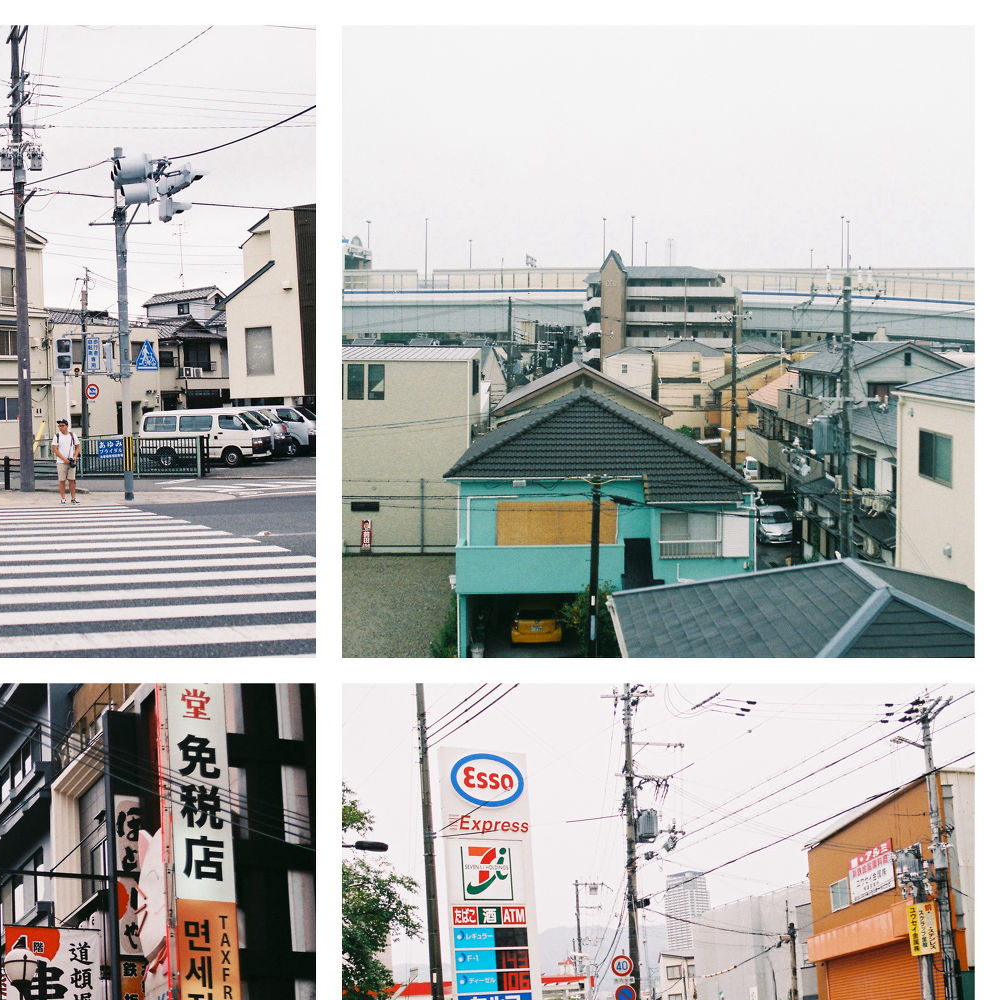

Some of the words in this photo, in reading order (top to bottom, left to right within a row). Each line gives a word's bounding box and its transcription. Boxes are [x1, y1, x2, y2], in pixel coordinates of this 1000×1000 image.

[99, 440, 122, 448] あゆみ
[181, 689, 211, 721] 堂
[463, 766, 514, 791] Esso
[178, 734, 223, 881] 免税店
[459, 815, 529, 834] Express
[454, 908, 476, 923] たばこ
[482, 908, 497, 923] 酒
[503, 908, 525, 923] ATM
[467, 954, 479, 962] F-1
[501, 952, 529, 969] 143
[616, 960, 628, 970] 40
[503, 972, 531, 991] 106
